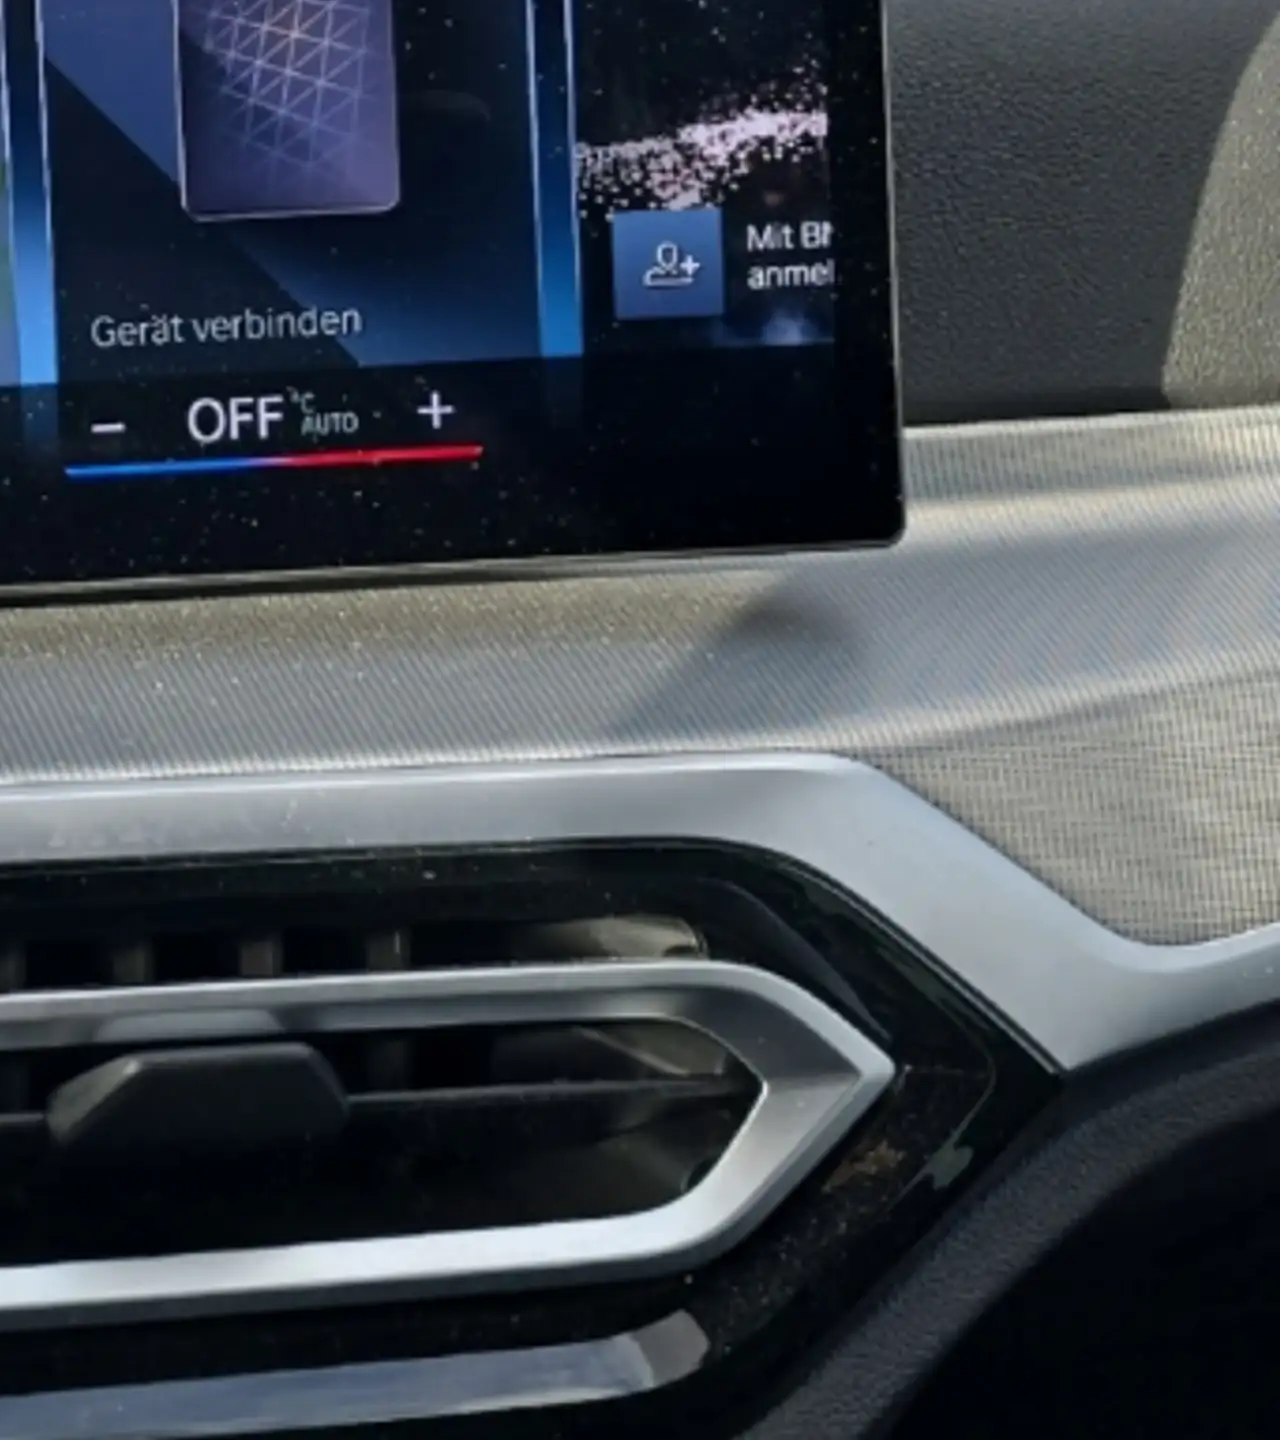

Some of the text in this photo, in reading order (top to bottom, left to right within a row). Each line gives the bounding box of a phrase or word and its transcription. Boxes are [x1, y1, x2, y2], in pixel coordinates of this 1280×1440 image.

[746, 222, 795, 252] Mit
[90, 306, 362, 348] Gerät verbinden
[188, 394, 285, 444] OFF
[300, 411, 360, 437] AUTO
